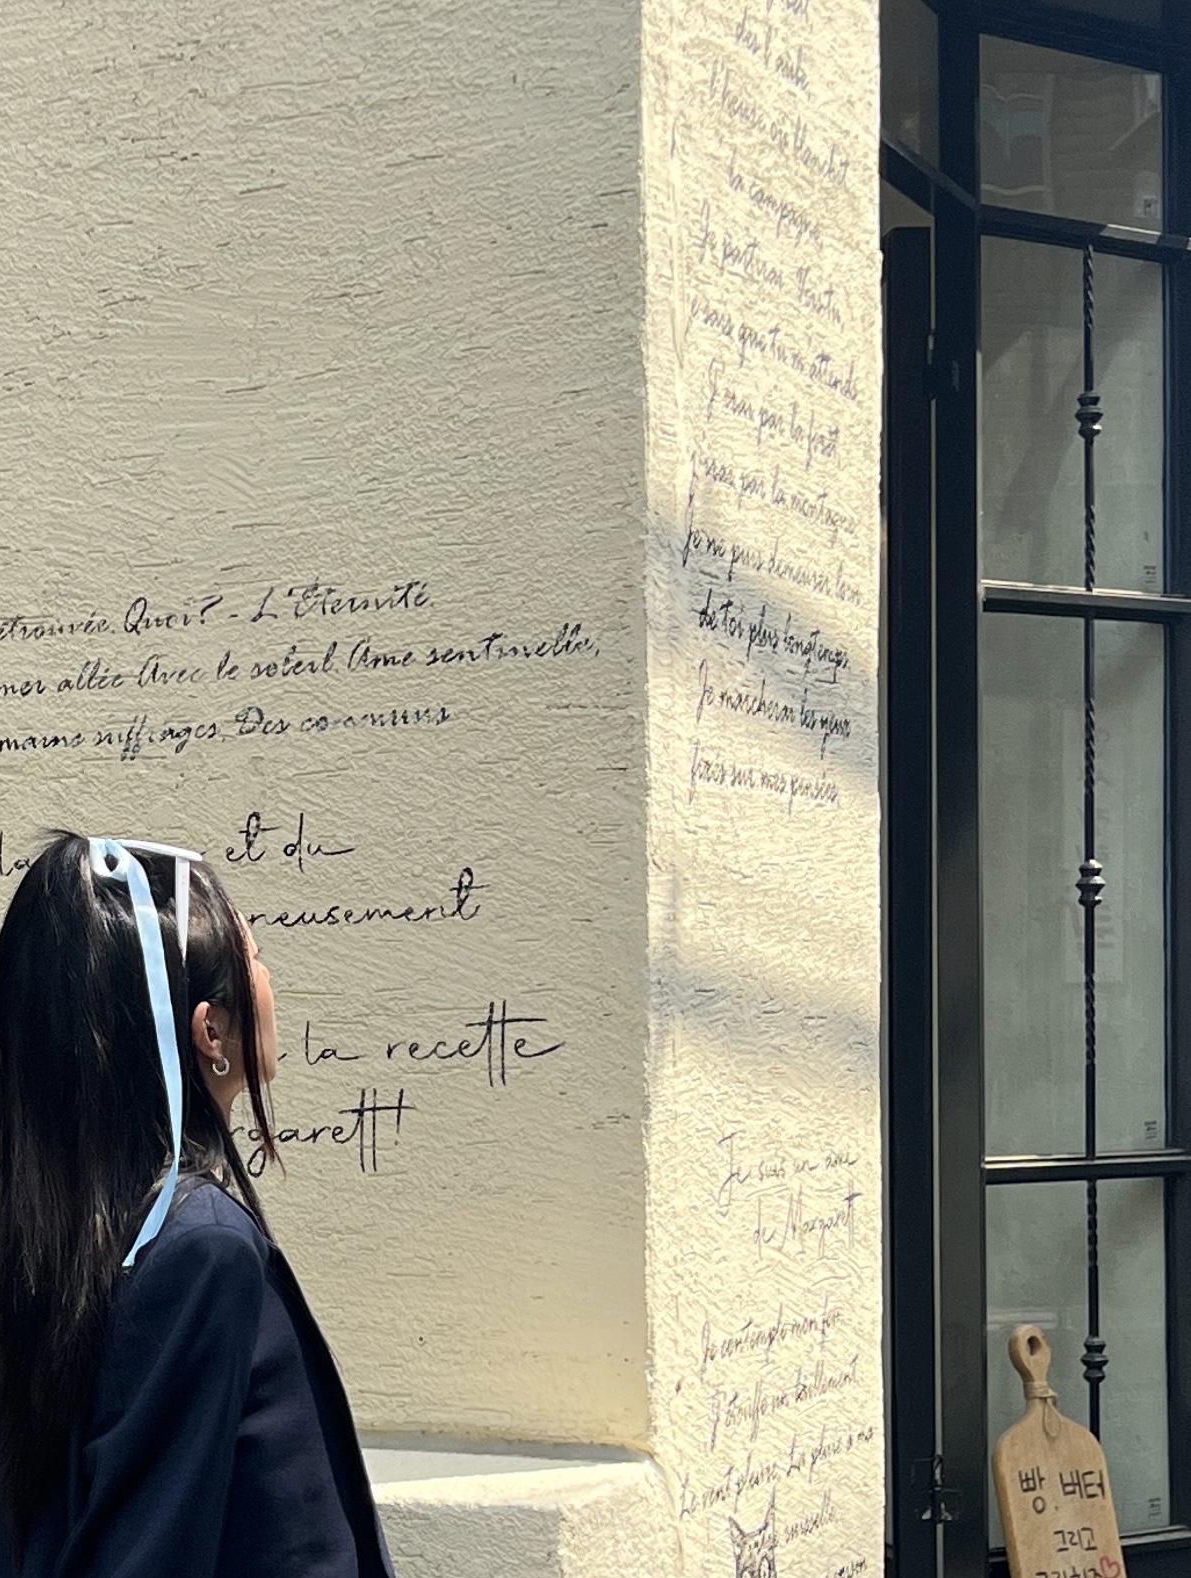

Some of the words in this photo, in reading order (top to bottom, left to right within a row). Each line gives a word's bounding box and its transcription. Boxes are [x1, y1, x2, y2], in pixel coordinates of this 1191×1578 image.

[245, 866, 490, 928] reusement
[306, 1023, 366, 1067] la
[386, 1000, 566, 1087] recette
[230, 1088, 418, 1178] rgarett!
[1059, 1468, 1106, 1500] 버터
[1053, 1526, 1098, 1553] 그리고
